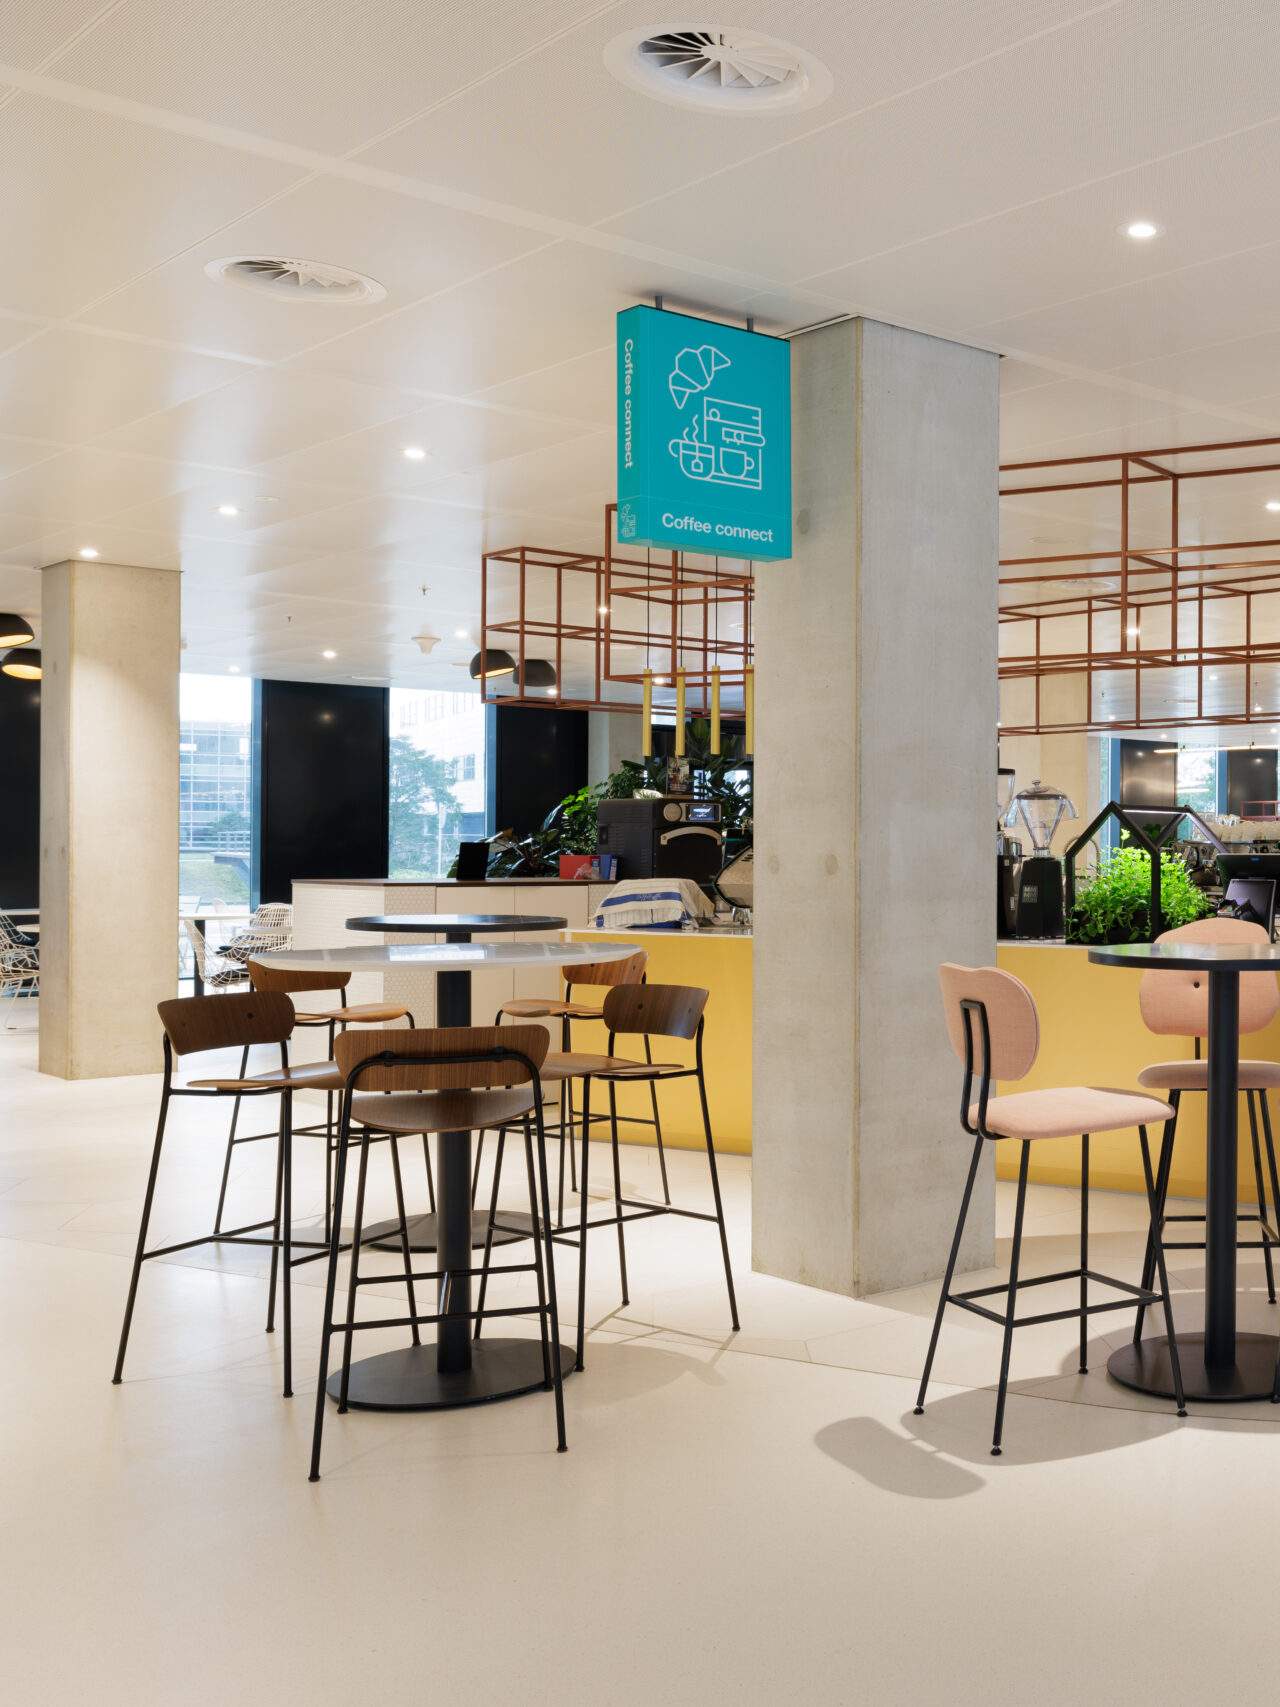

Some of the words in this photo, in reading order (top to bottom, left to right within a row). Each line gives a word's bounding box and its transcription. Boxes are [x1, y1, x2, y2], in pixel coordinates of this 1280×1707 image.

[624, 339, 634, 395] Coffee
[624, 399, 634, 469] connect
[662, 512, 712, 534] Coffee
[715, 523, 774, 543] connect
